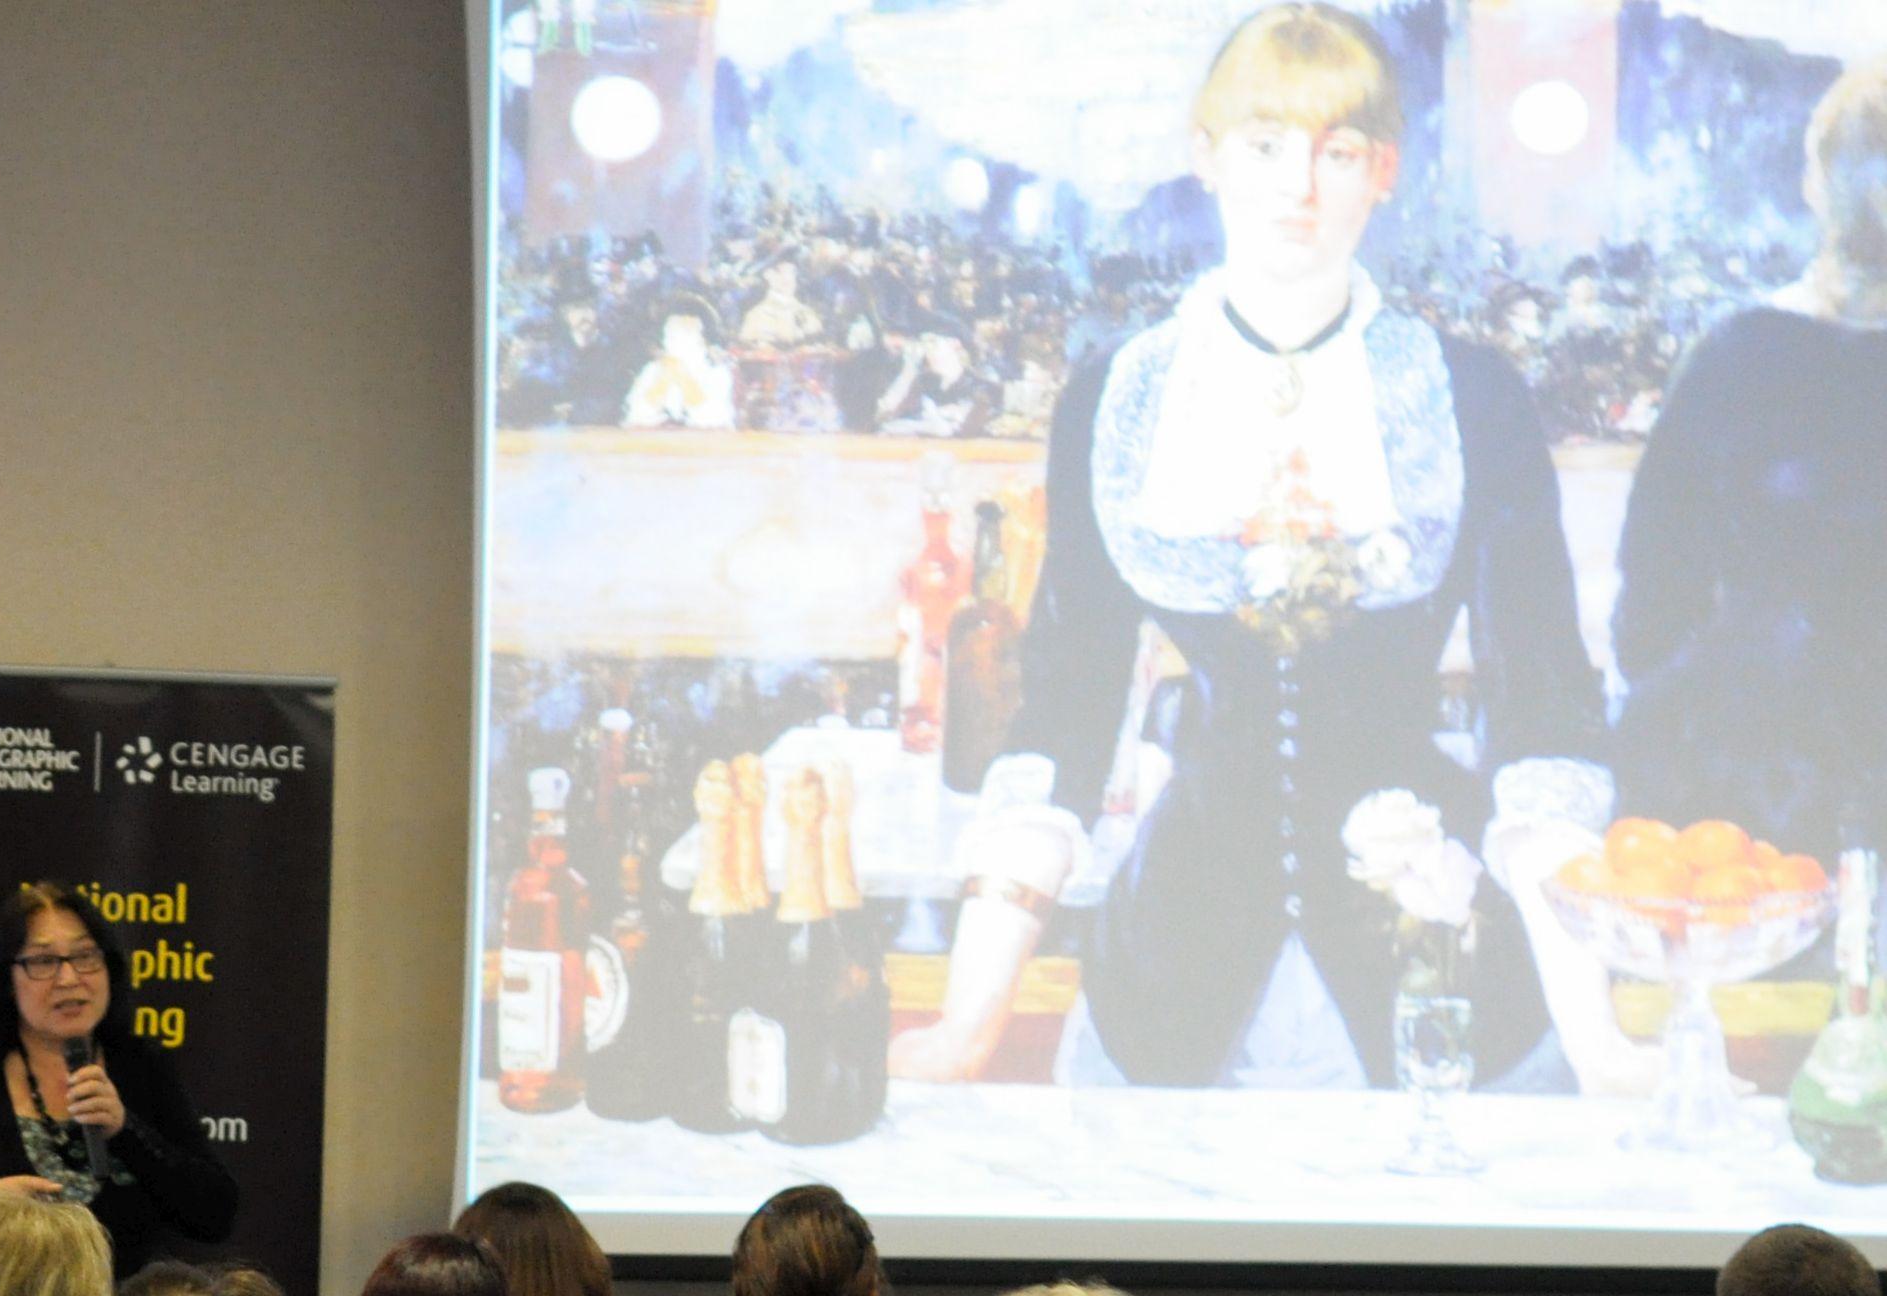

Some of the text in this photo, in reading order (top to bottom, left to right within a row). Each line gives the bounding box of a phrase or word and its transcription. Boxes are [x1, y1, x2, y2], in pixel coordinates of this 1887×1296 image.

[169, 742, 305, 769] CENGAGE
[171, 770, 277, 803] Learning
[76, 882, 187, 924] ional
